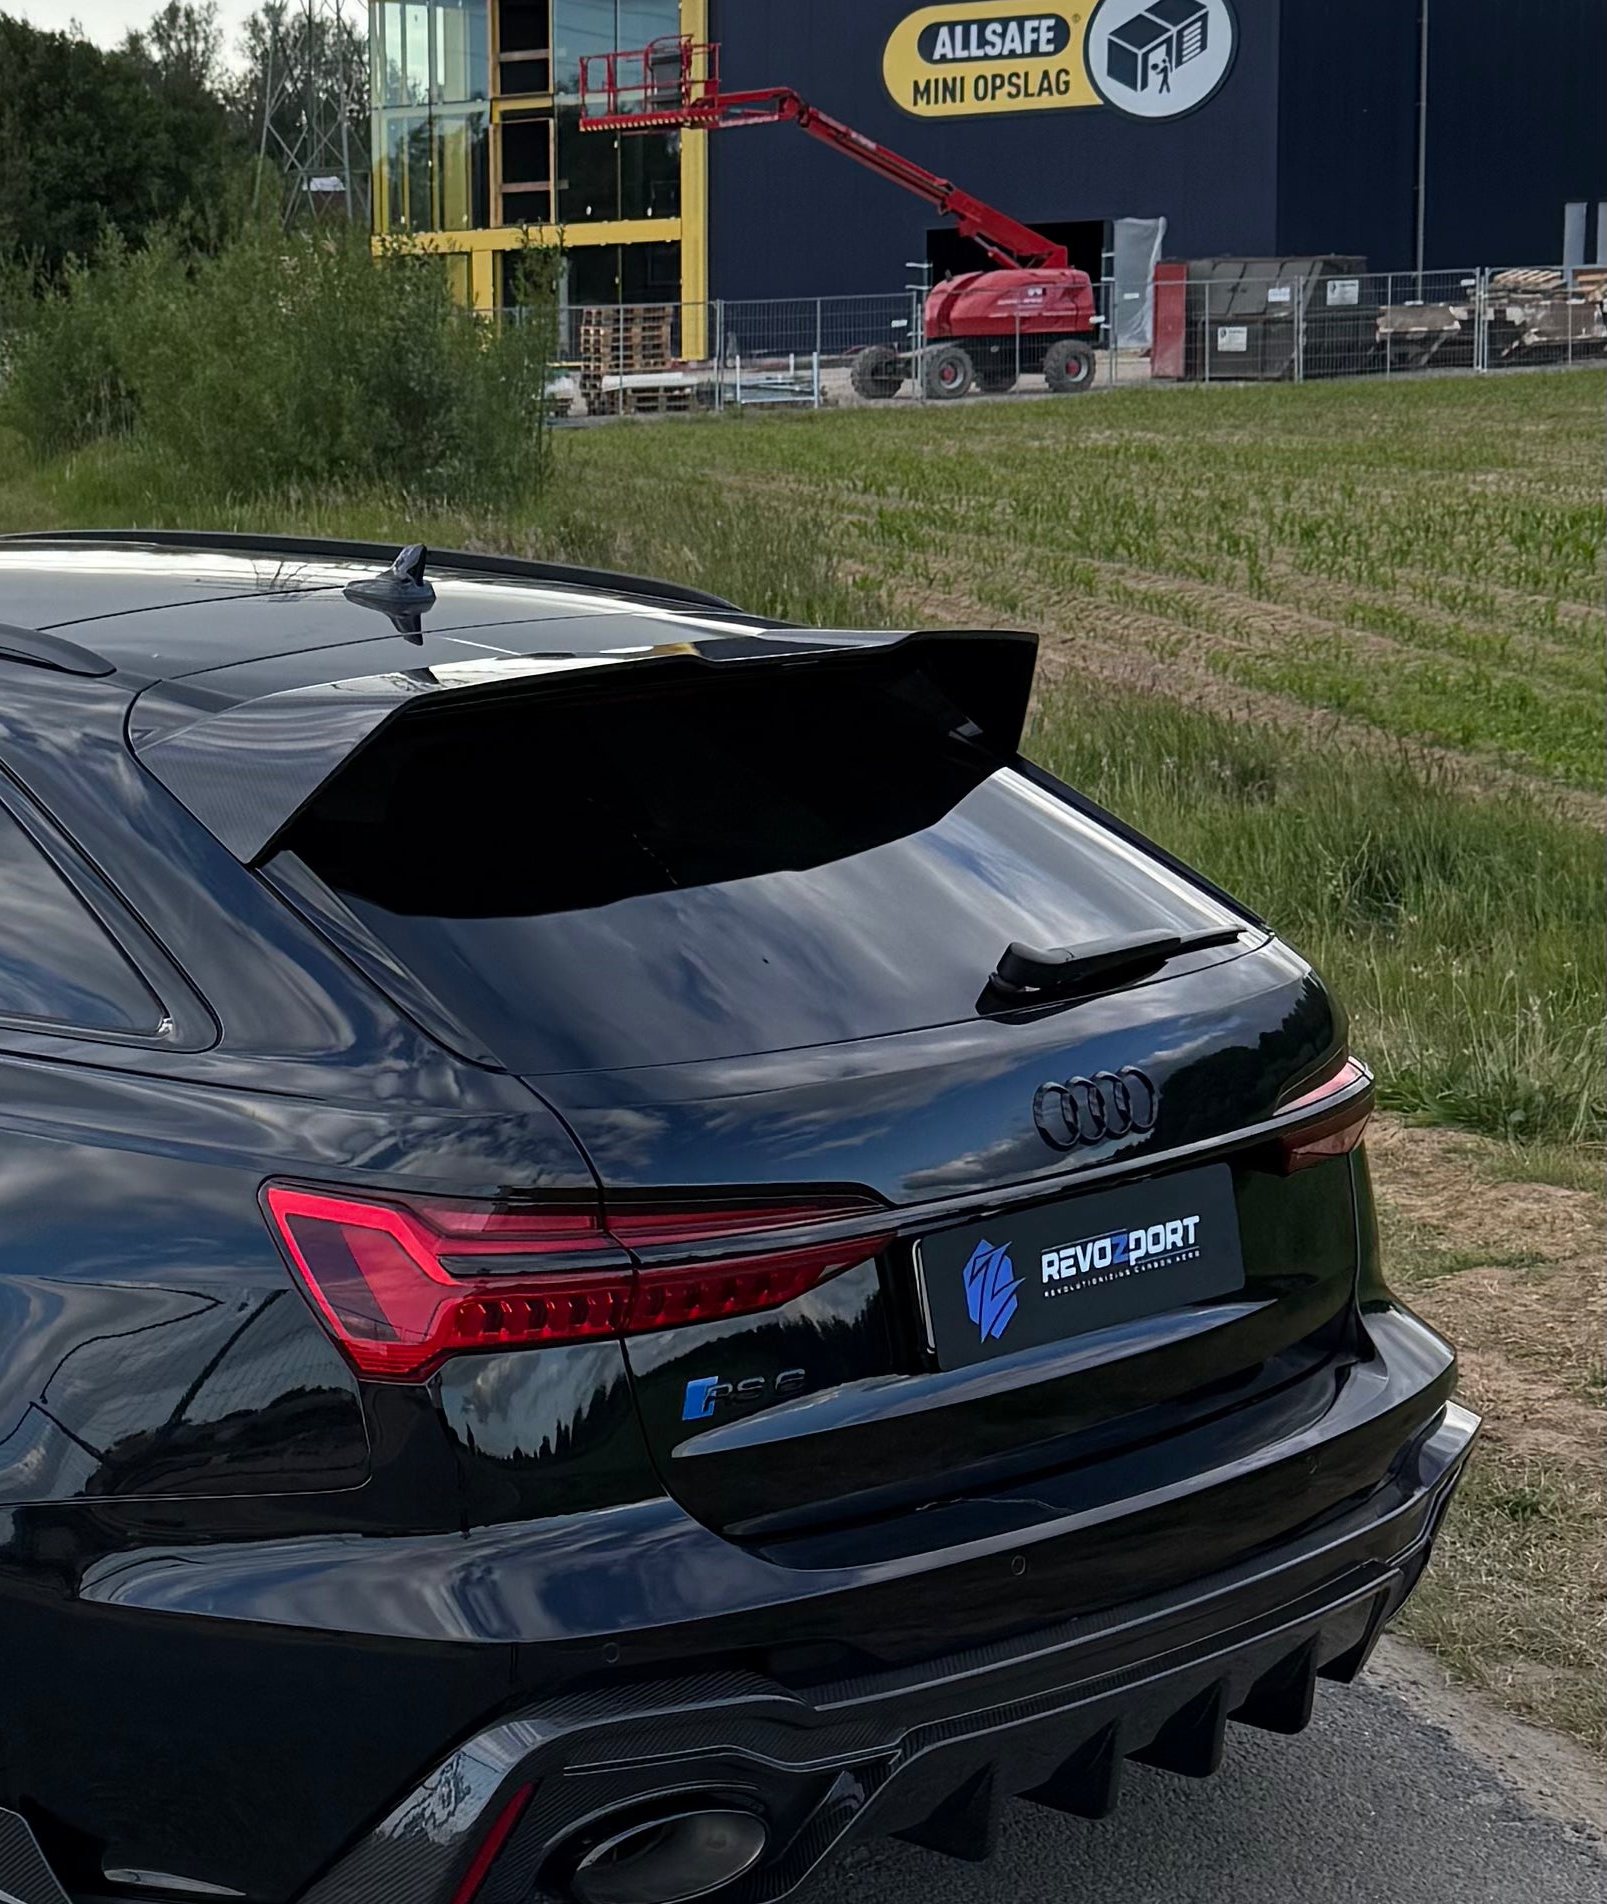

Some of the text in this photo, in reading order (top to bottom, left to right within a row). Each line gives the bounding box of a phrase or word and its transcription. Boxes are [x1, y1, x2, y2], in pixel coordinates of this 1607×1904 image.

[932, 18, 1056, 60] ALLSAFE
[912, 68, 1071, 107] MINI OPSLAG
[1041, 1214, 1201, 1284] REVOZPORT
